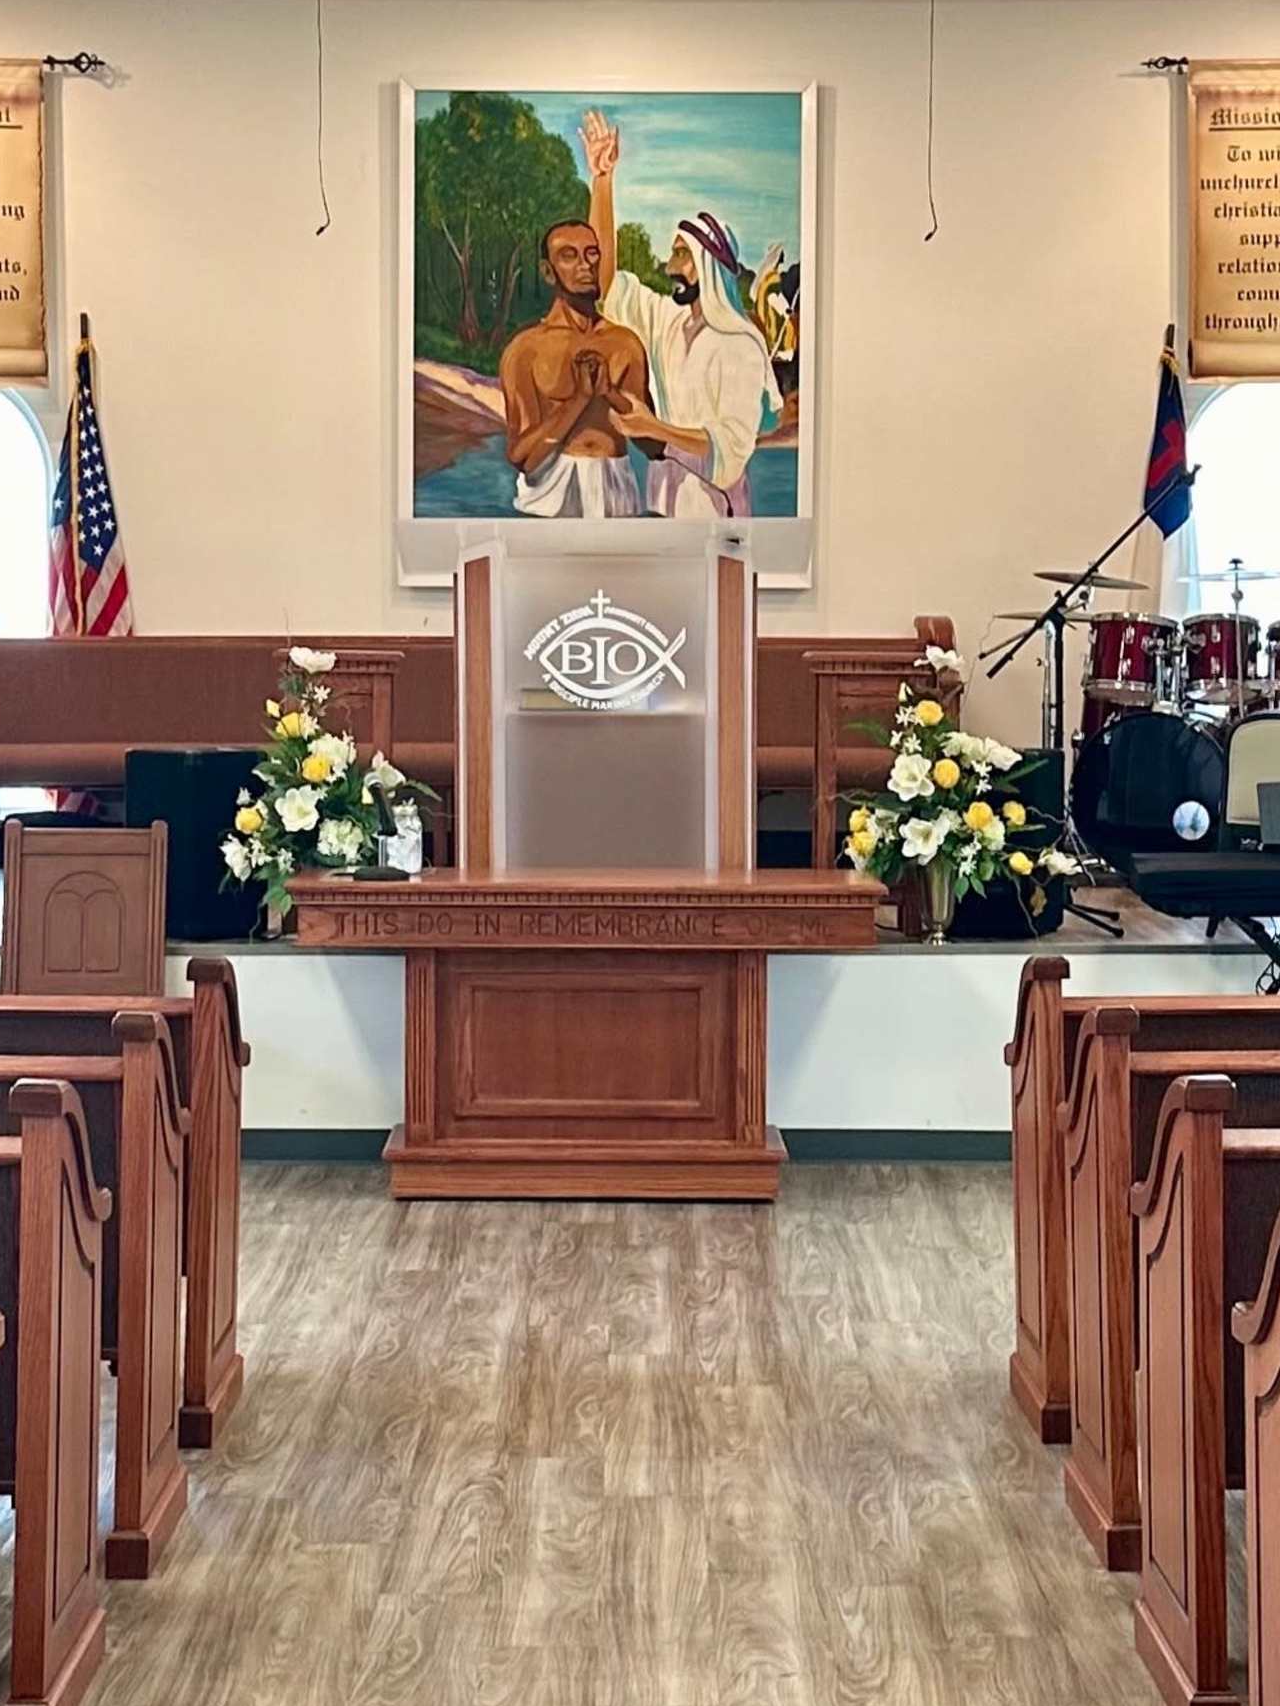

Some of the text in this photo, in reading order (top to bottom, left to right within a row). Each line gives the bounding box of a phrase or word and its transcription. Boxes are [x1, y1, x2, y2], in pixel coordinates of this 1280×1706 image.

[1226, 145, 1251, 162] To
[332, 911, 400, 936] THIS
[417, 911, 454, 935] DO
[473, 912, 501, 936] IN
[519, 911, 725, 936] REMEMBRANCE
